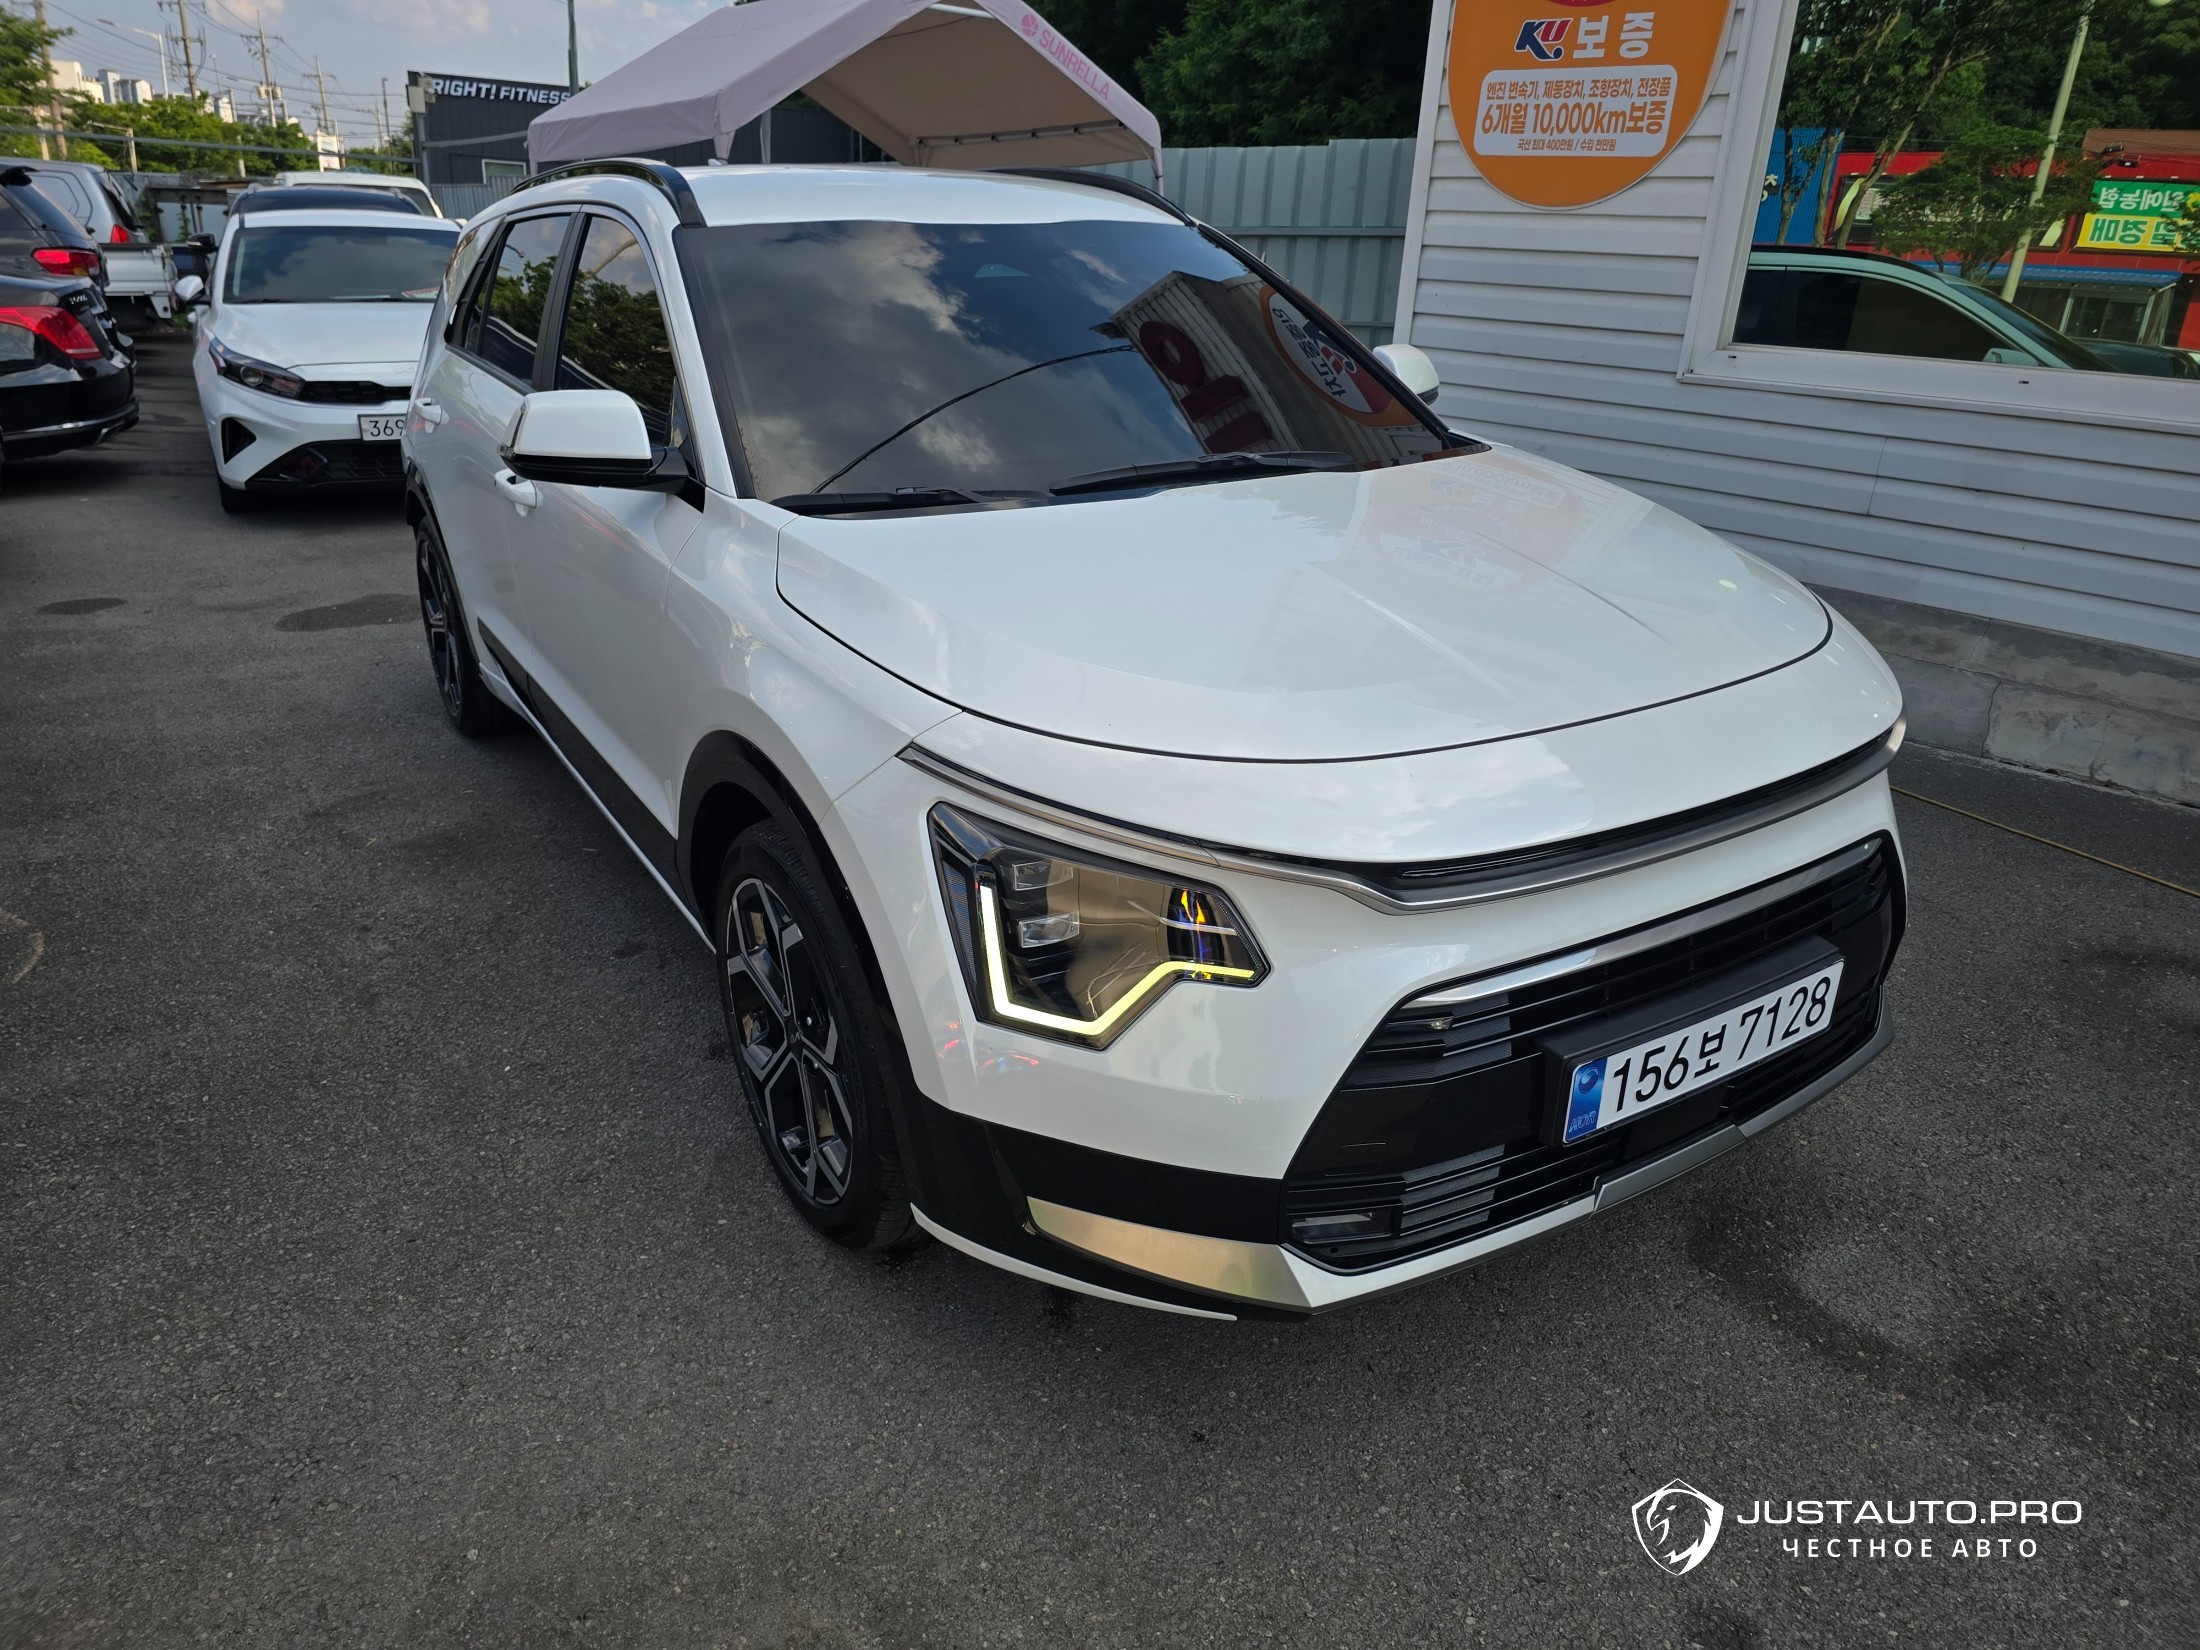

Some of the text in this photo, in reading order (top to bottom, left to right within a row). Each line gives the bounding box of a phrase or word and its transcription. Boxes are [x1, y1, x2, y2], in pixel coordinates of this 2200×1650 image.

[1040, 29, 1110, 100] SUNRELLA
[500, 86, 570, 105] FITNESS
[1486, 76, 1672, 100] 엔진 변속기, 제동장치, 조향장치, 전장품
[1481, 102, 1529, 135] 6개월
[1517, 139, 1531, 151] 국산
[1532, 139, 1546, 151] 최대
[1546, 139, 1574, 151] 400만원
[1580, 139, 1594, 151] 수입
[369, 419, 405, 437] 369
[1613, 976, 1832, 1113] 156보 7128
[1568, 1109, 1597, 1133] KOR
